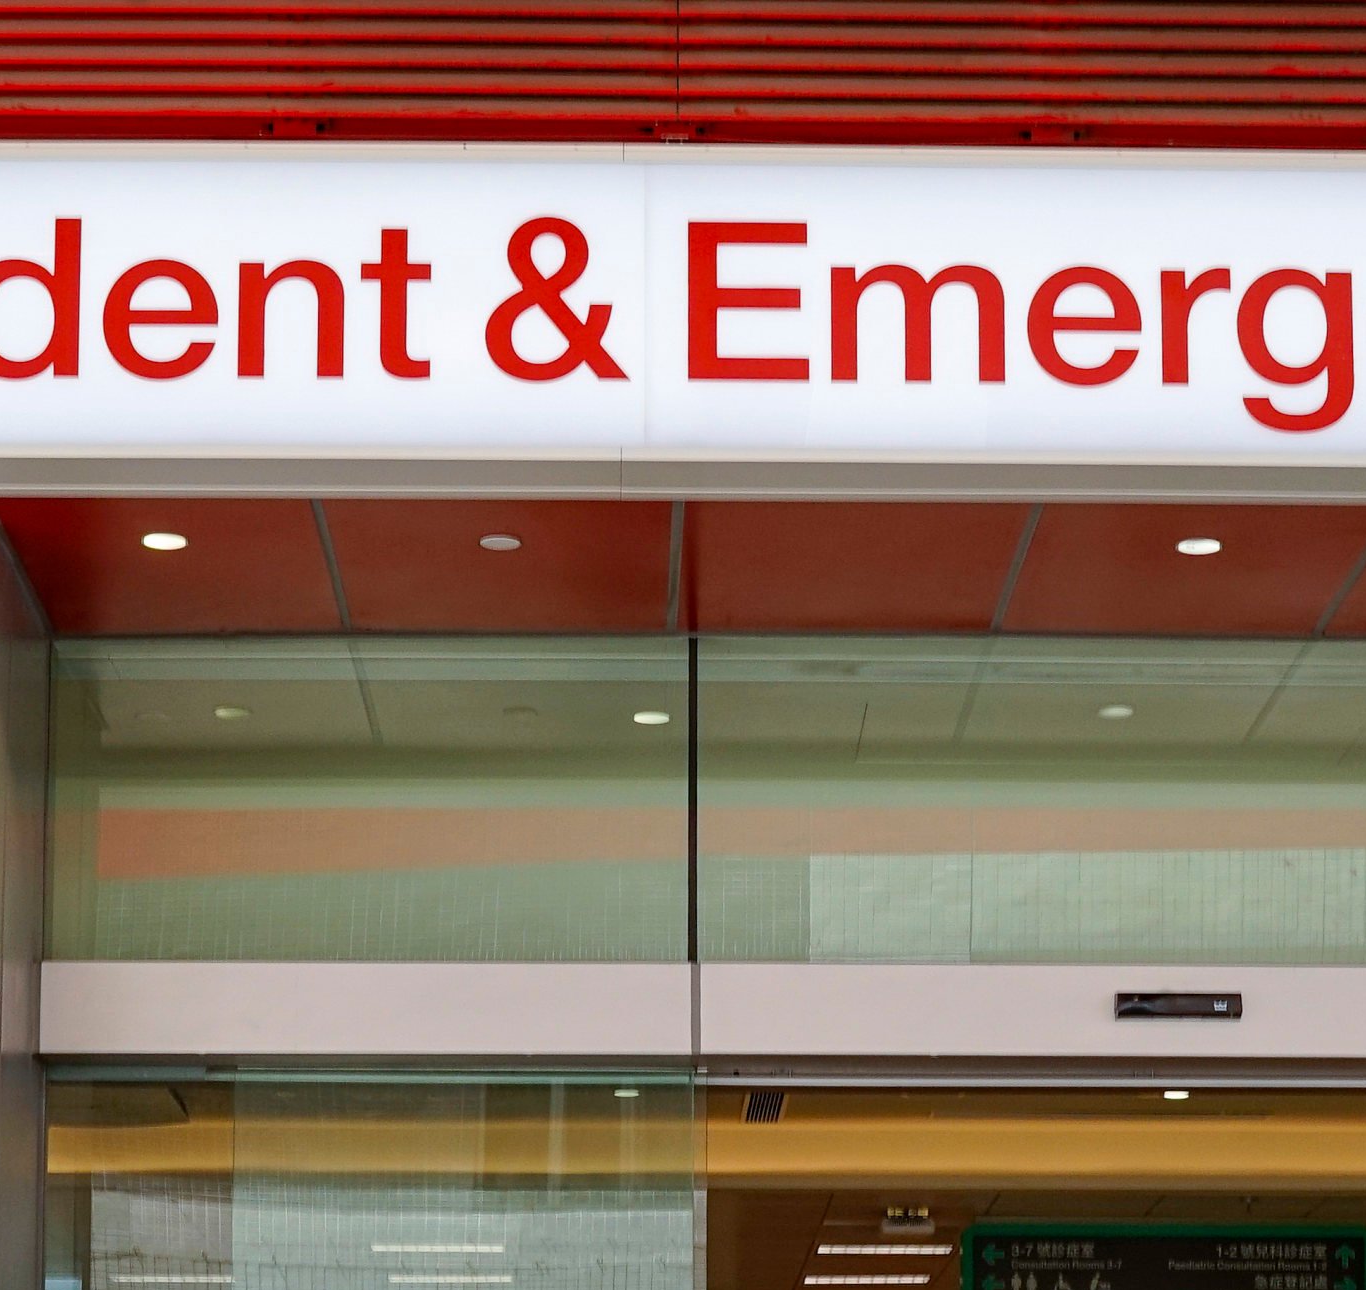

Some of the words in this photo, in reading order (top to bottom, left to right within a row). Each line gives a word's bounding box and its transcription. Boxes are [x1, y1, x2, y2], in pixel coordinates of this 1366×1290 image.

[486, 217, 627, 382] &
[1011, 1242, 1034, 1258] 3-7
[1215, 1242, 1238, 1259] 1-2
[1011, 1259, 1071, 1271] Consultation
[1072, 1259, 1105, 1270] Rooms
[1167, 1259, 1216, 1272] Paediatric
[1217, 1260, 1276, 1271] Consultation
[1278, 1260, 1311, 1271] Rooms
